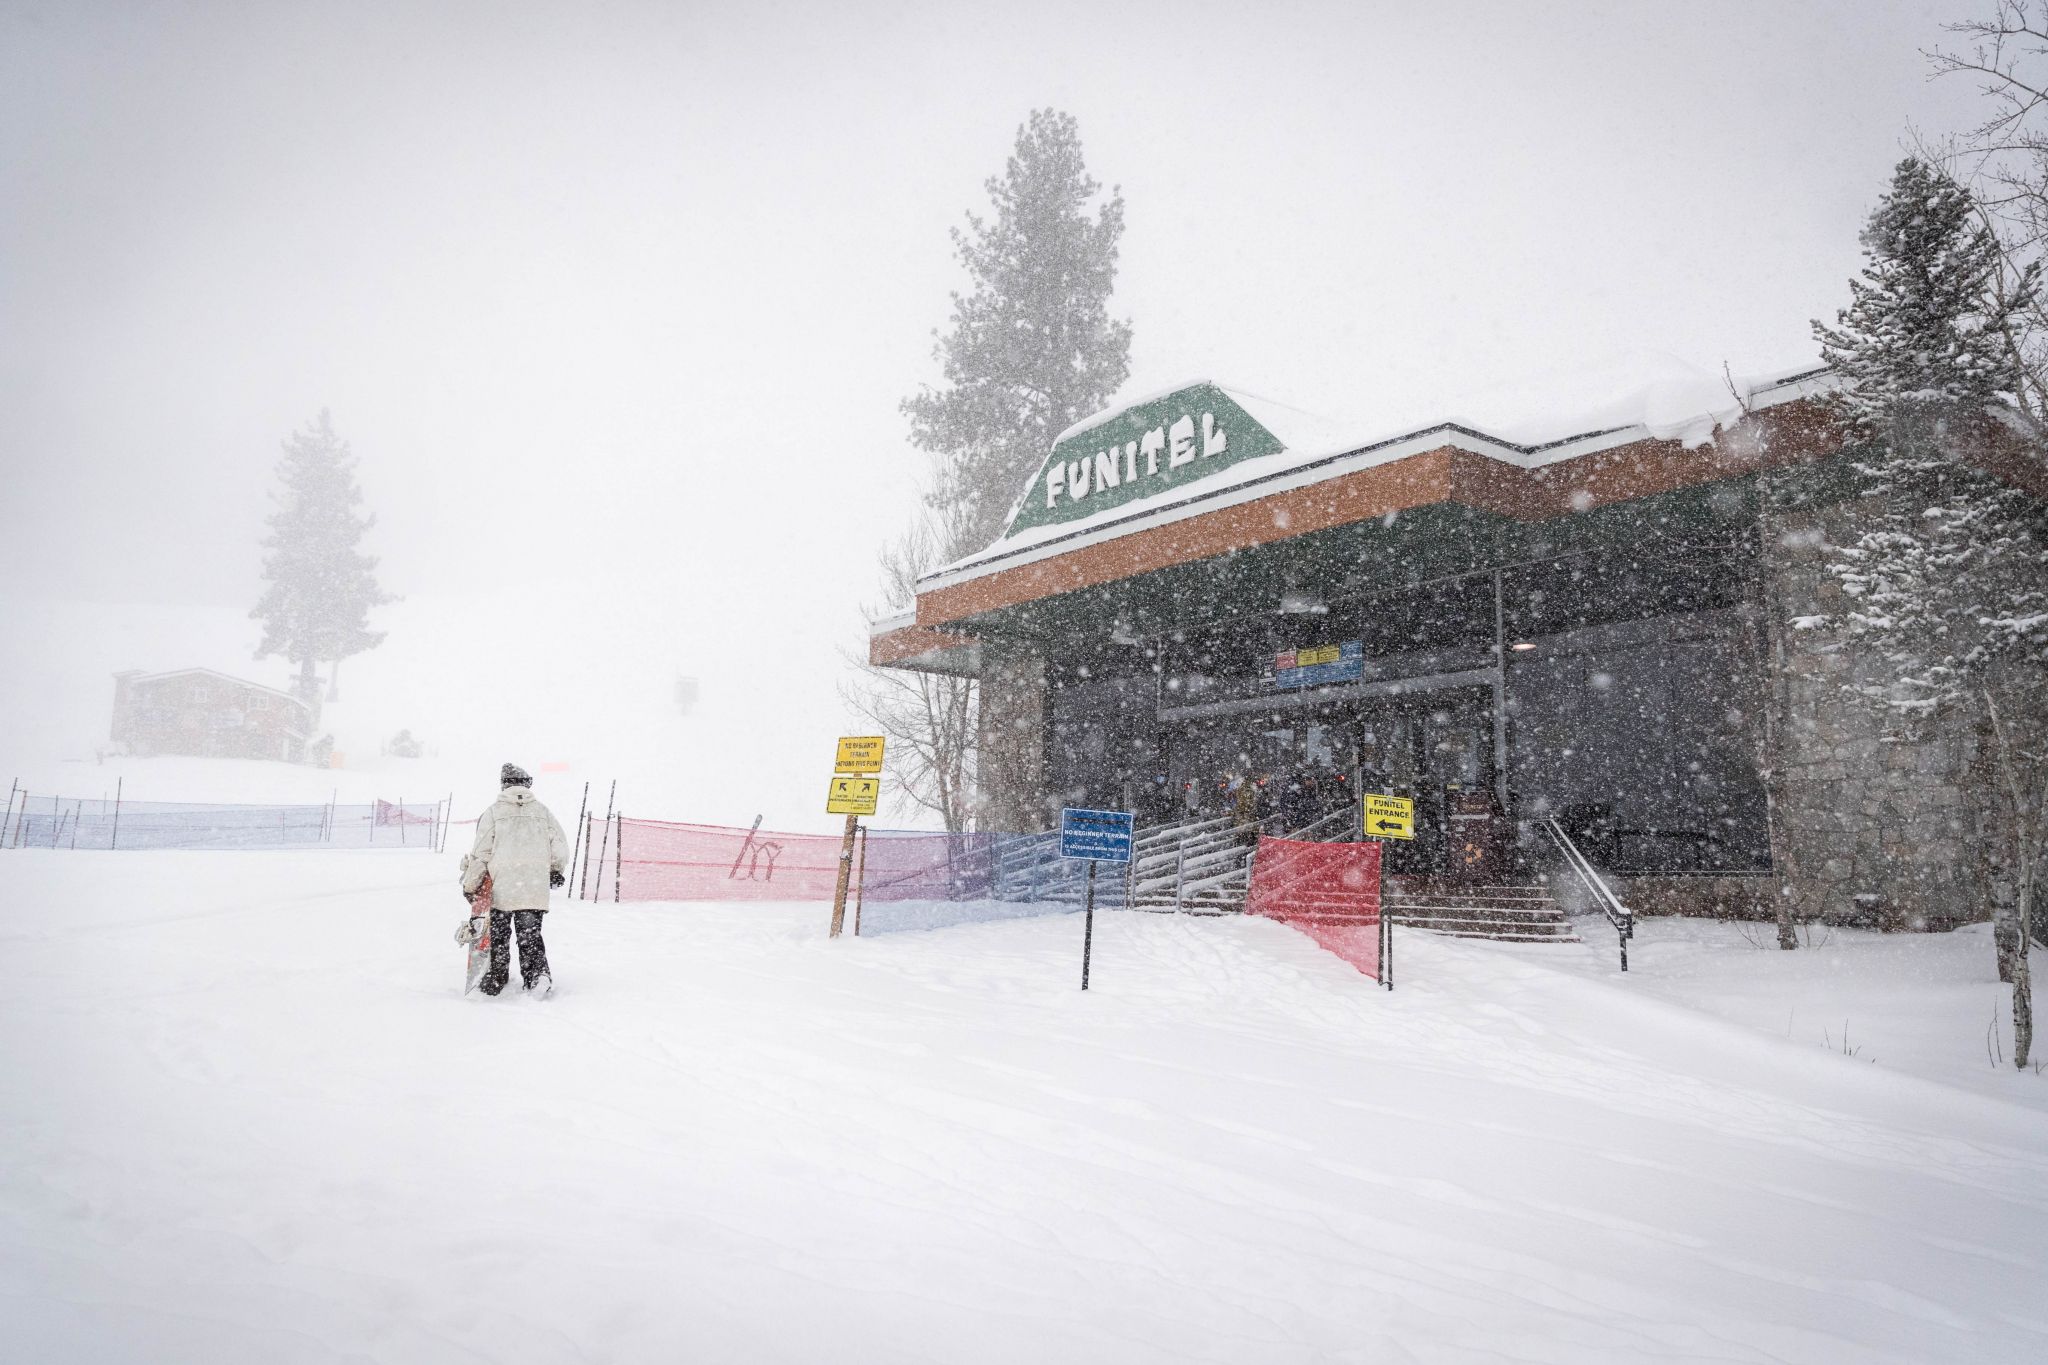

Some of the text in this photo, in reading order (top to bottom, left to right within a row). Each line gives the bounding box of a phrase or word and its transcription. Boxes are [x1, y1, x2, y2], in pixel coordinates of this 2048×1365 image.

[1046, 412, 1227, 508] FUNITEL
[1373, 799, 1405, 810] FUNITEL
[1369, 808, 1410, 819] ENTRANCE
[1074, 830, 1104, 838] BEGINNER
[1104, 832, 1129, 840] TERRAIN
